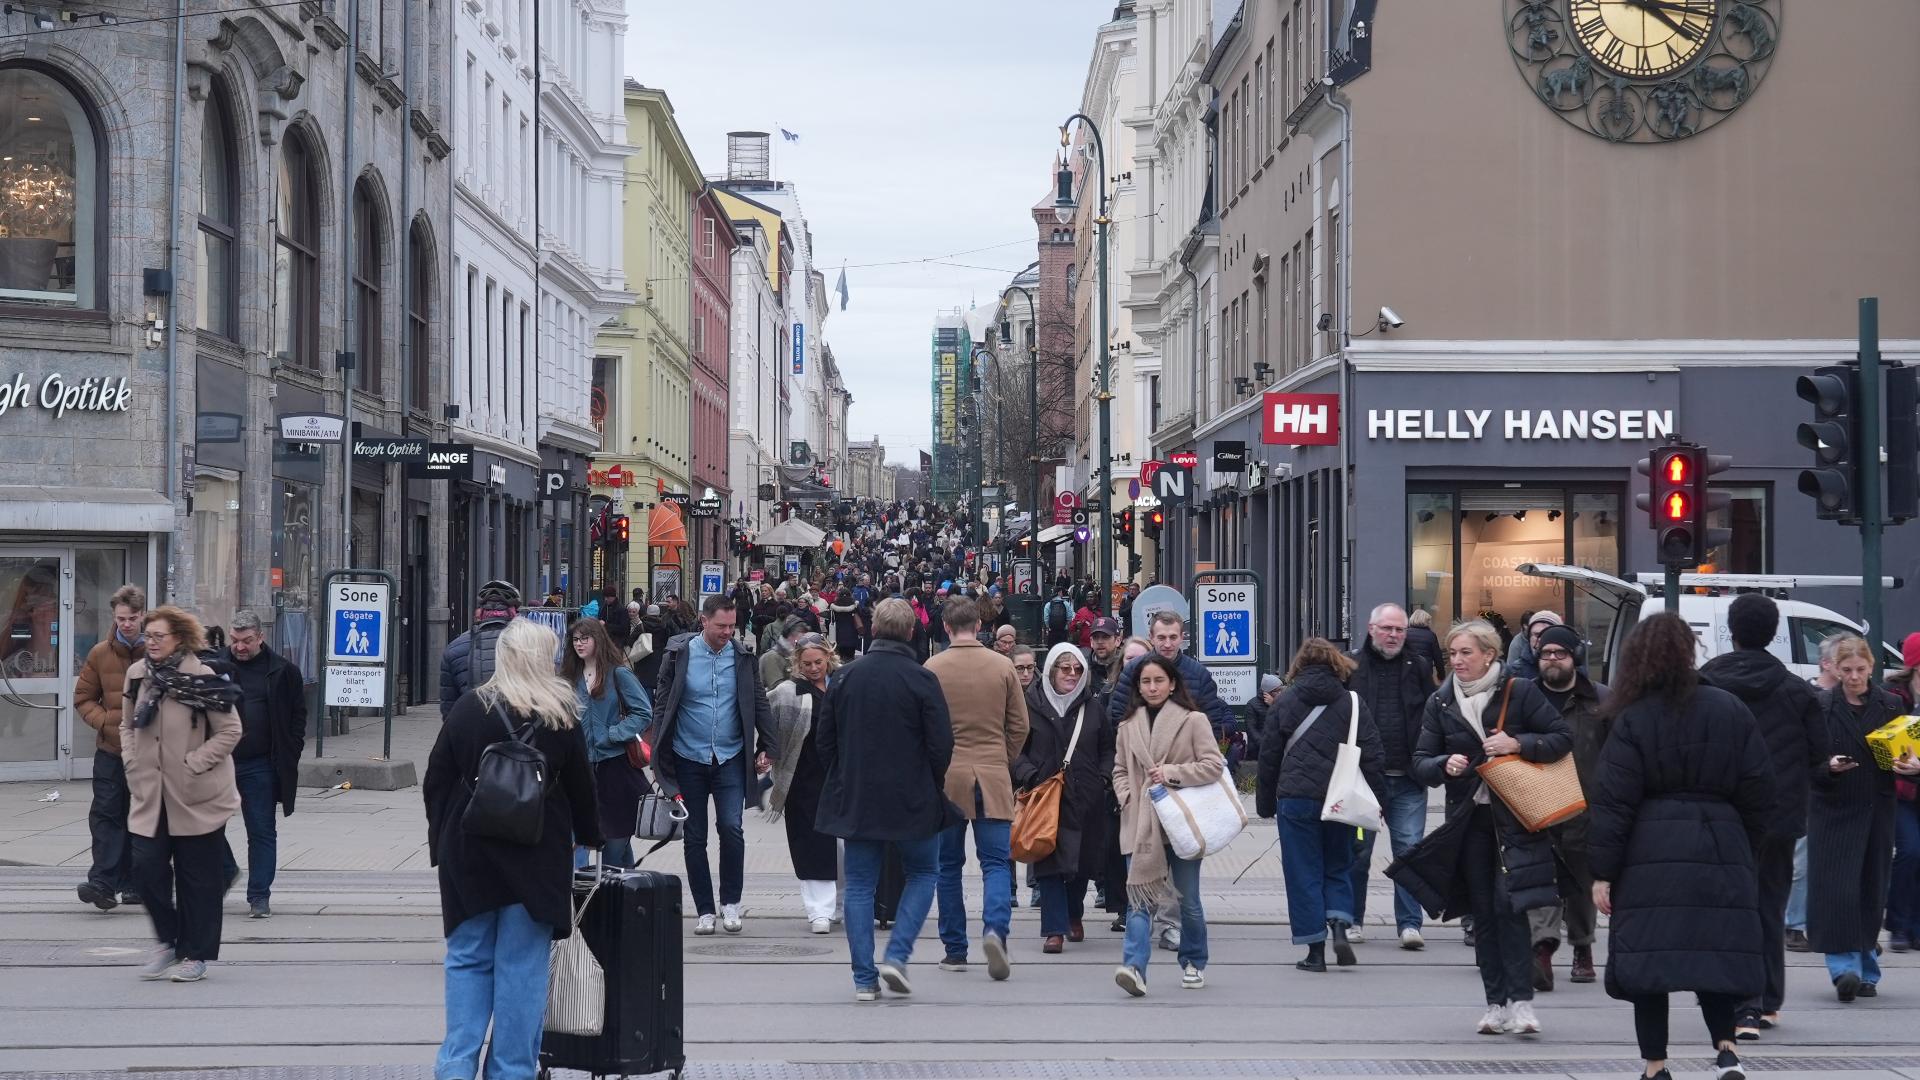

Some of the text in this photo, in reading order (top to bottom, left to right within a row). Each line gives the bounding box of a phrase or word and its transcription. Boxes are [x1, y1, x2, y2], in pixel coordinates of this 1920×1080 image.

[41, 373, 132, 419] Optikk
[942, 353, 956, 445] BETONMAST
[1274, 404, 1328, 434] HH
[1368, 409, 1674, 440] HELLY HANSEN
[286, 429, 339, 438] MINIBANK/ATM
[354, 441, 423, 458] Krogh Optikk
[1217, 452, 1242, 460] Glitter
[1160, 471, 1184, 496] N
[1483, 575, 1541, 587] MODERN
[340, 588, 378, 602] Sone
[1207, 589, 1246, 602] Sone
[343, 611, 374, 621] Gågate
[1211, 611, 1242, 622] Gågate
[330, 669, 381, 678] Varetransport
[1209, 670, 1251, 678] aretransport
